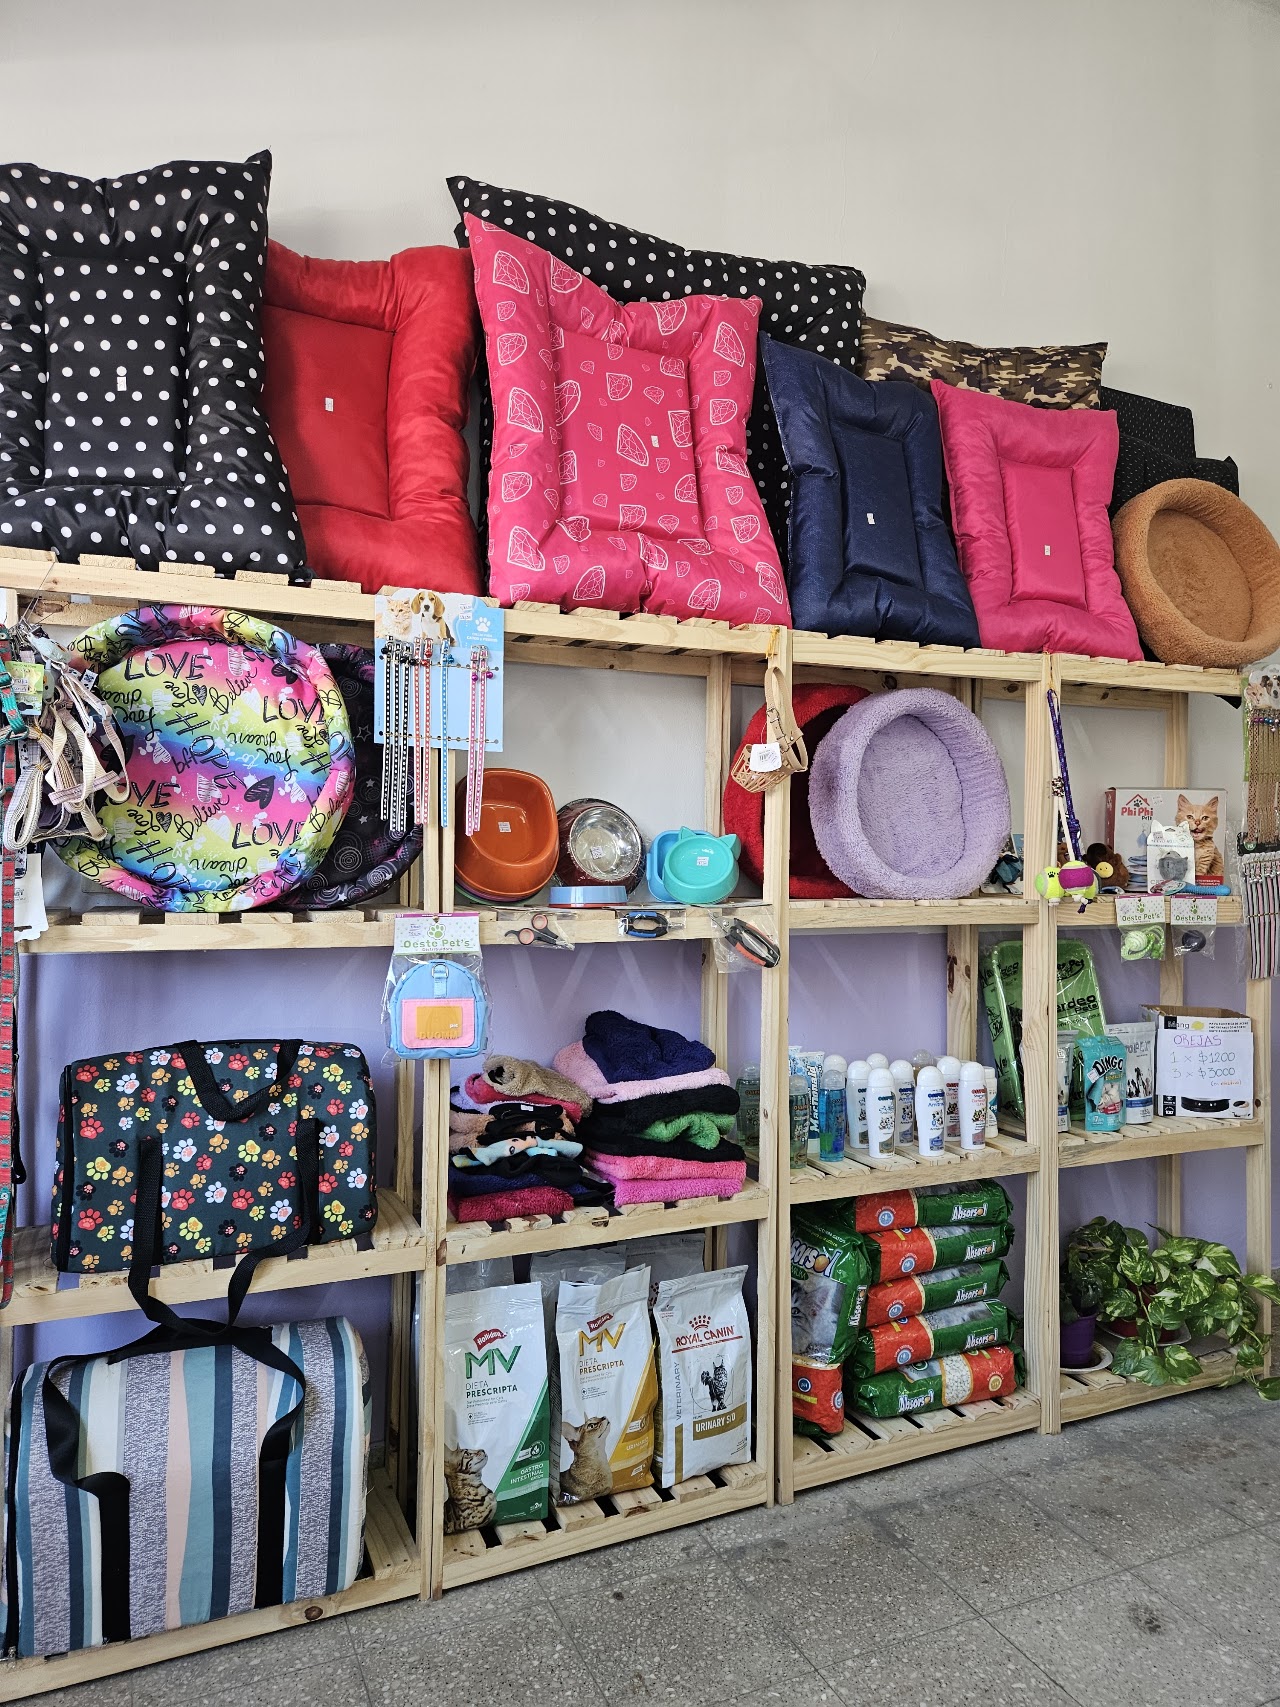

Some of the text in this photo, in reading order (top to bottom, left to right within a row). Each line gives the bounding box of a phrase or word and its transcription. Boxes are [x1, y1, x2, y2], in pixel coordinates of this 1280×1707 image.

[124, 652, 212, 681] LOVE
[1122, 914, 1141, 922] Oeste
[403, 939, 470, 948] Oeste Pet's
[1057, 995, 1096, 1013] erdeo
[1173, 1034, 1222, 1046] OREJAS
[1170, 1051, 1179, 1063] 1
[1198, 1051, 1235, 1064] $1200
[1172, 1068, 1181, 1078] 3
[1198, 1067, 1236, 1079] $3000
[791, 1239, 843, 1278] sorsol
[578, 1322, 626, 1357] MV
[675, 1325, 735, 1347] ROYAL CANIN
[465, 1345, 522, 1379] MV
[579, 1357, 598, 1368] DIETA
[579, 1359, 625, 1376] PRESCRIPTA
[466, 1380, 489, 1390] DIETA
[466, 1384, 518, 1399] PRESCRIPTA
[674, 1361, 682, 1421] VETERINARY
[695, 1417, 725, 1433] URINARY
[520, 1463, 544, 1475] GASTRO
[510, 1470, 544, 1485] INTESTINAL
